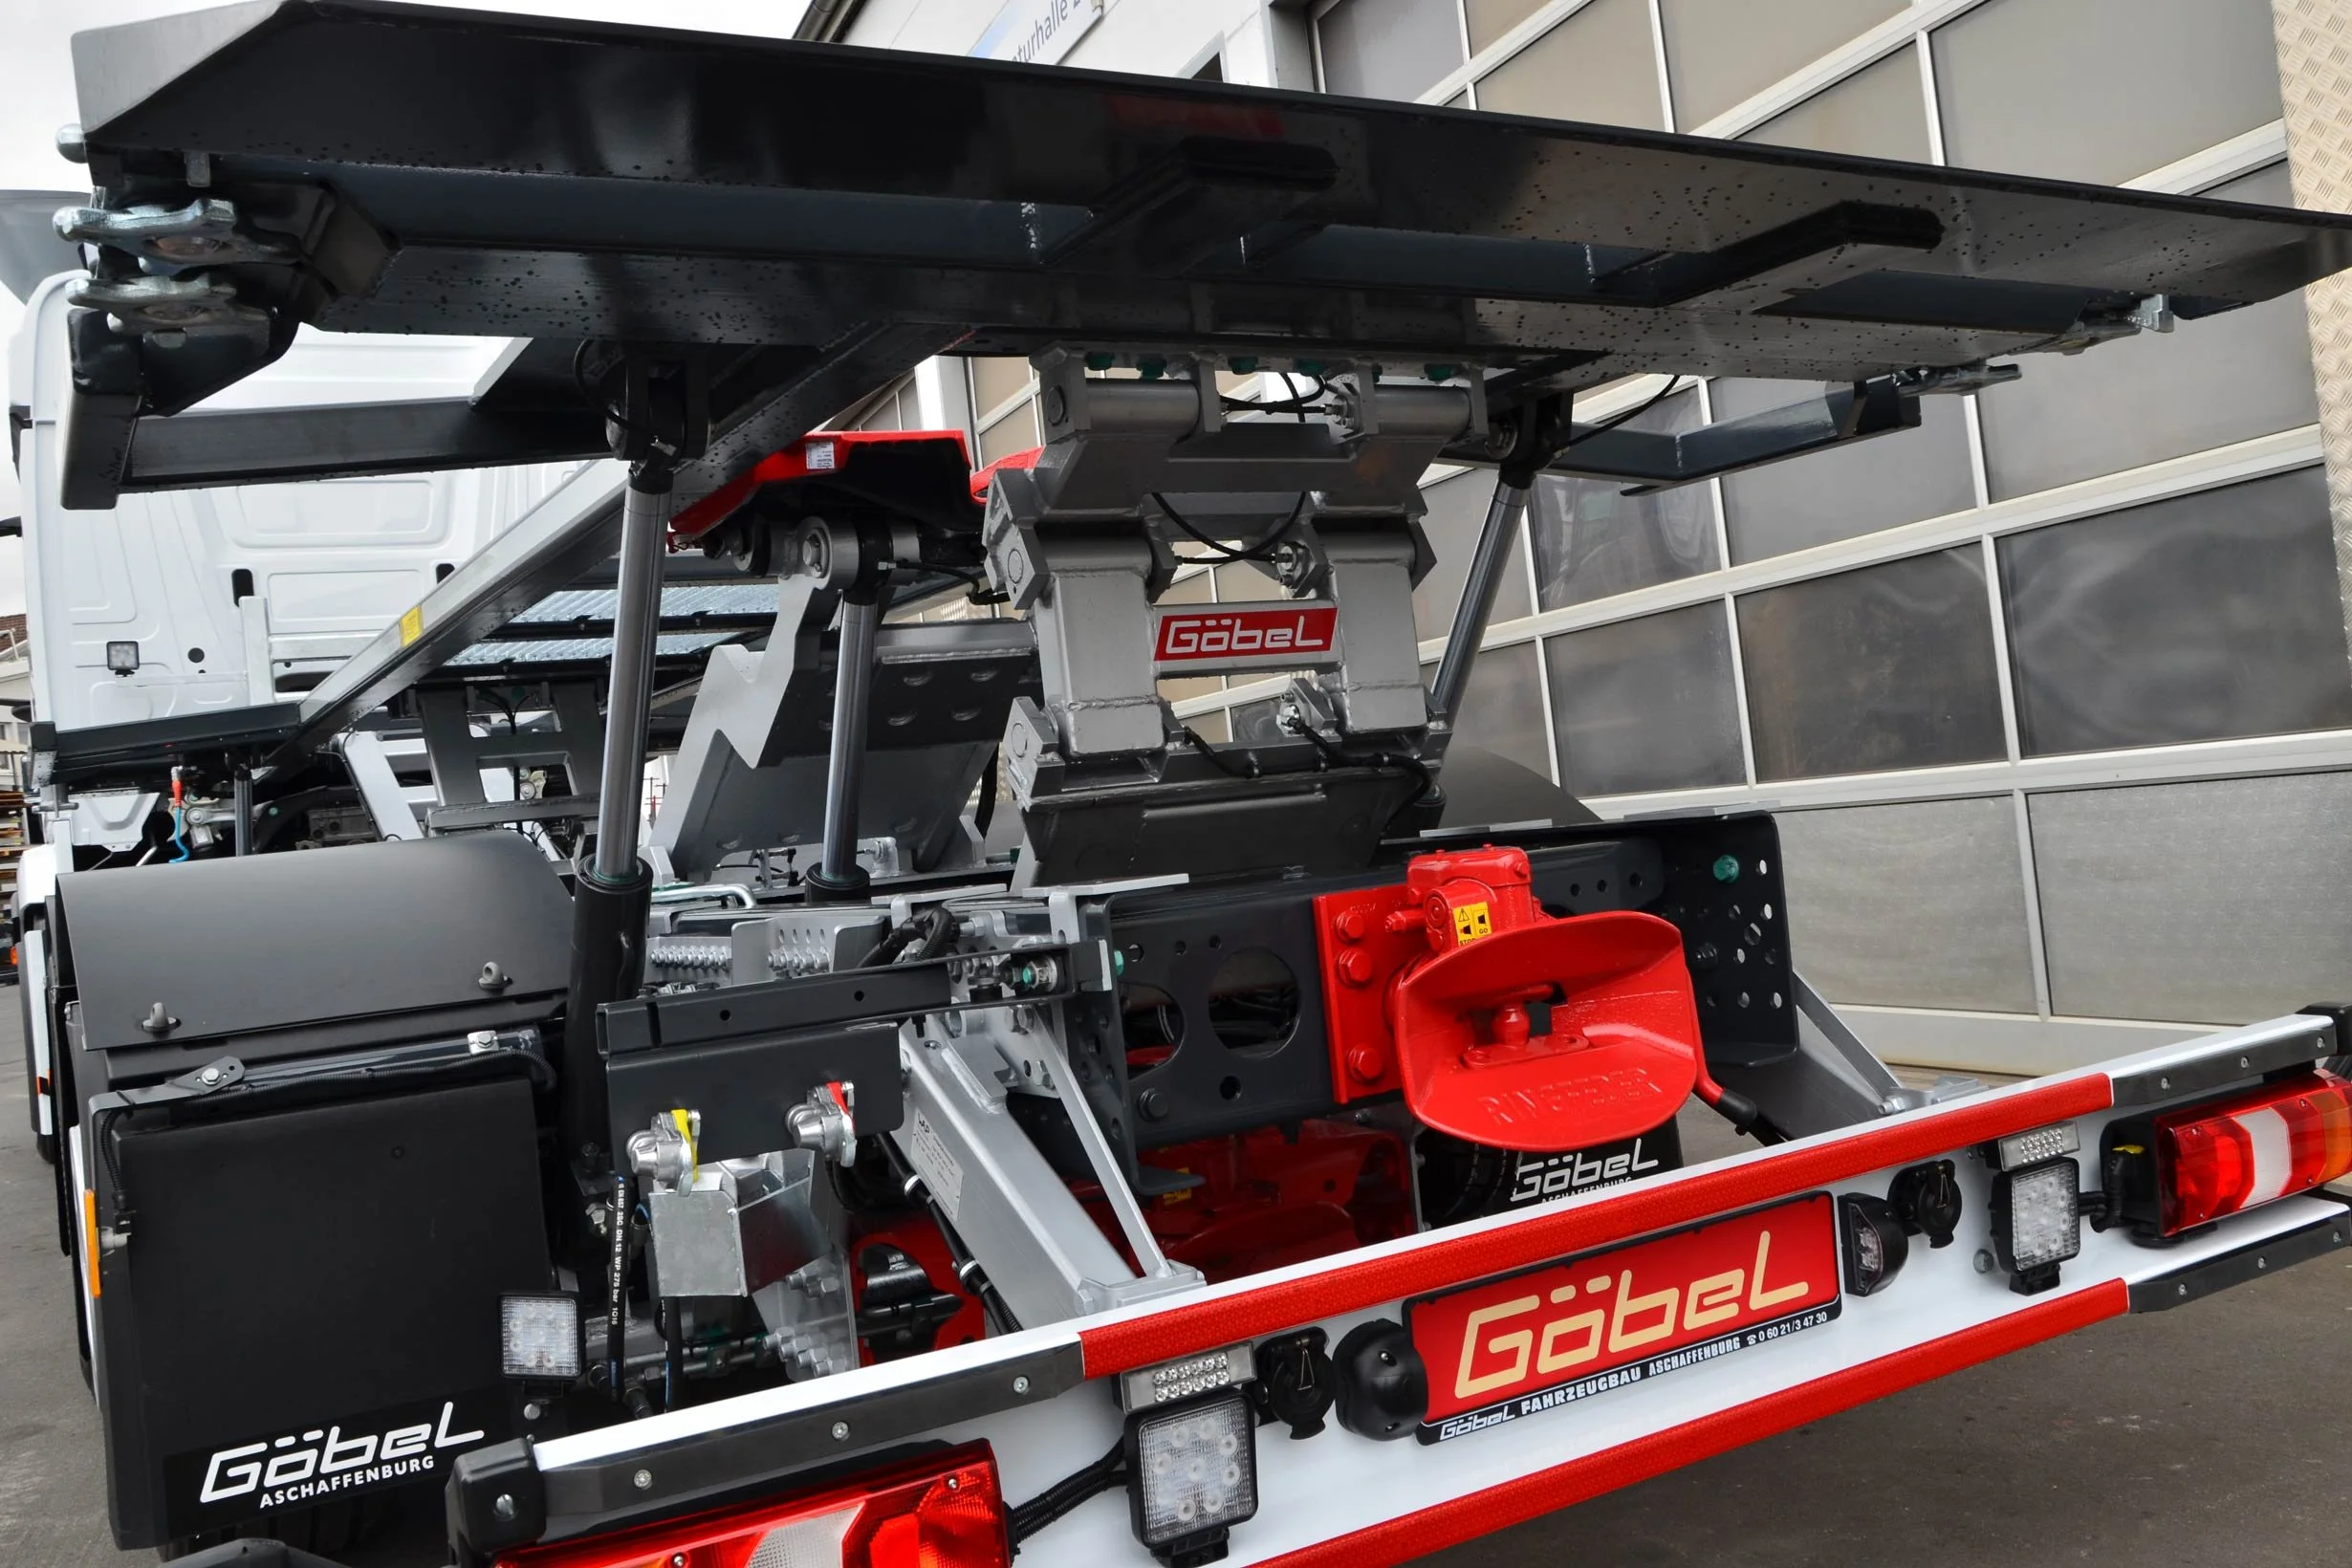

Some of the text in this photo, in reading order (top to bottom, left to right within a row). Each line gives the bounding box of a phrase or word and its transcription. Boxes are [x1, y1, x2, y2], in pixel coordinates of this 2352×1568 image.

[616, 1230, 623, 1242] DN
[615, 1243, 622, 1252] 12
[615, 1256, 621, 1271] WP
[1521, 1367, 1642, 1415] FAHRZEUGBAU
[1649, 1337, 1741, 1376] ASCHAFFENBURG
[1767, 1328, 1778, 1339] 60
[1803, 1316, 1814, 1327] 47
[1816, 1312, 1827, 1323] 30
[259, 1455, 434, 1508] ASCHAFFENBURG
